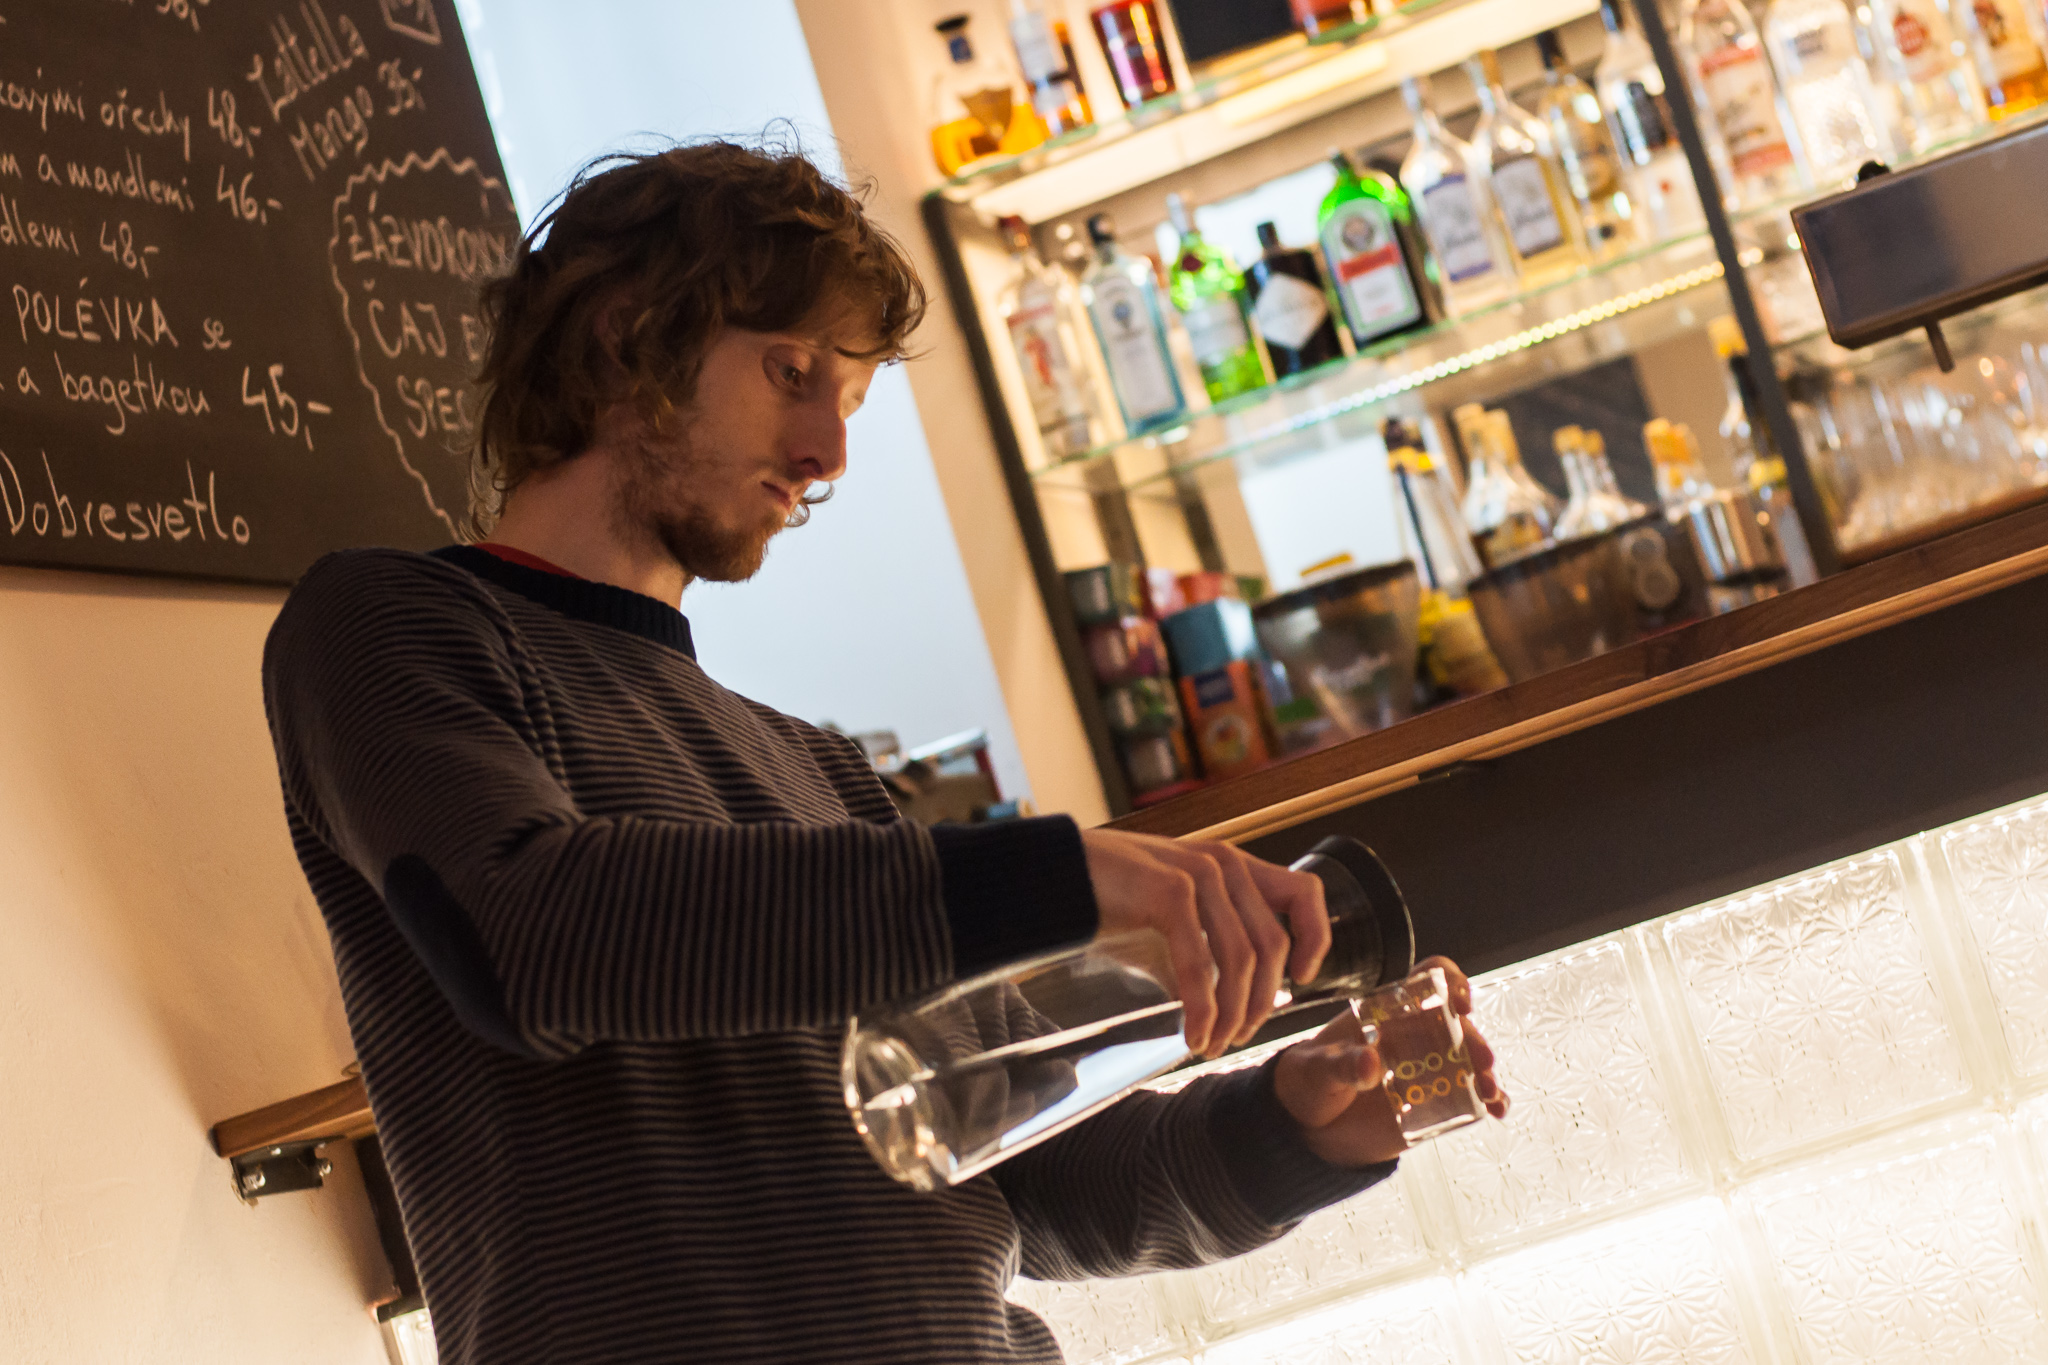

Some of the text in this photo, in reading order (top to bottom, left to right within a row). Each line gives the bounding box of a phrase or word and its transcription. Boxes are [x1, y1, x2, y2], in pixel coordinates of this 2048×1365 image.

[288, 84, 373, 182] Mango
[37, 152, 63, 188] a
[66, 145, 196, 213] mandlemi
[12, 276, 179, 343] POLÉVKA
[367, 278, 448, 358] ČAJ
[17, 365, 41, 396] a
[53, 349, 211, 436] bagetkou
[0, 448, 251, 546] Dobresvetlo
